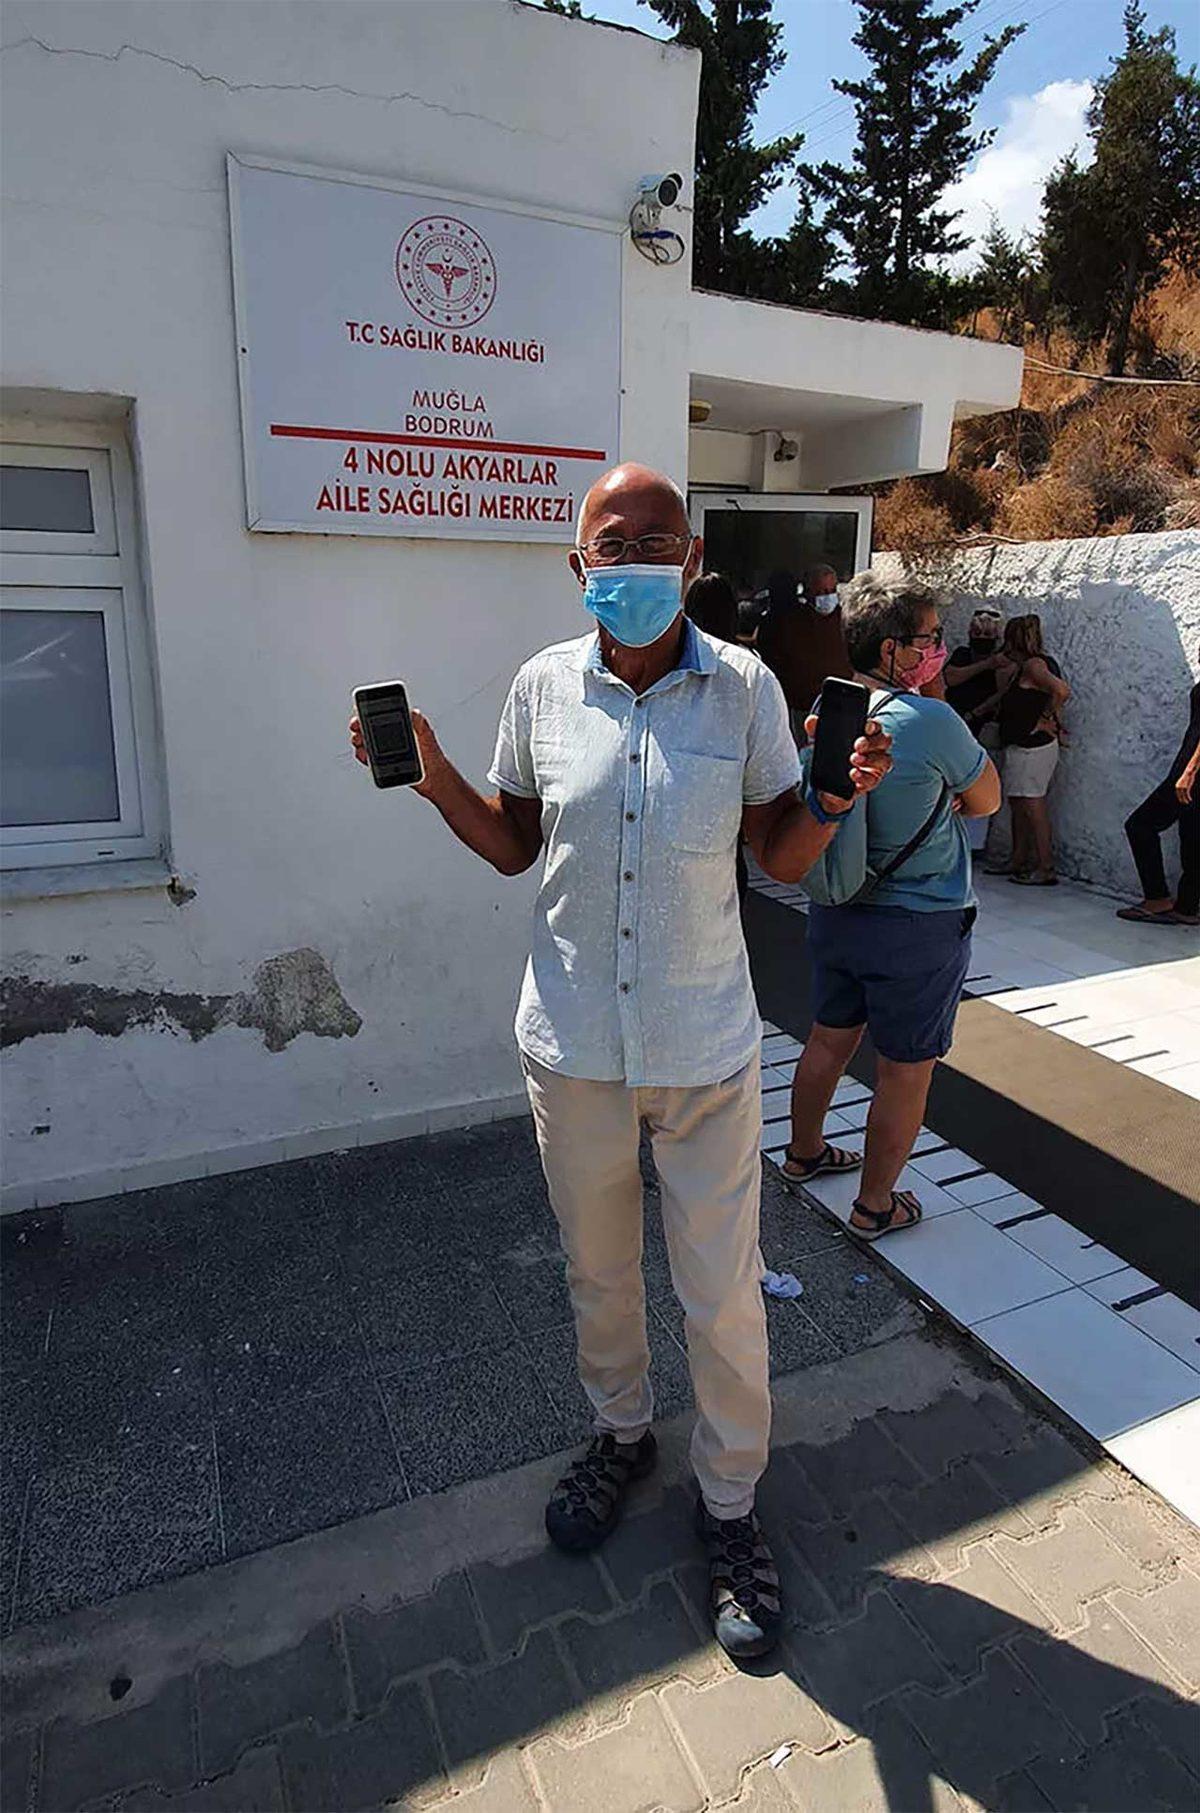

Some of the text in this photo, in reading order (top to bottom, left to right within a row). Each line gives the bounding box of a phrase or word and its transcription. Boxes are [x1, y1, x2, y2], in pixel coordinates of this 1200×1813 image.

[345, 320, 545, 364] T.C SAĞLIK BAKANLIĞI
[412, 388, 487, 414] MUĞLA
[405, 414, 494, 440] BODRUM
[343, 446, 559, 487] 4 NOLU AKYARLAR
[315, 477, 575, 524] AİLE SAĞLIĞI MERKEZİ
